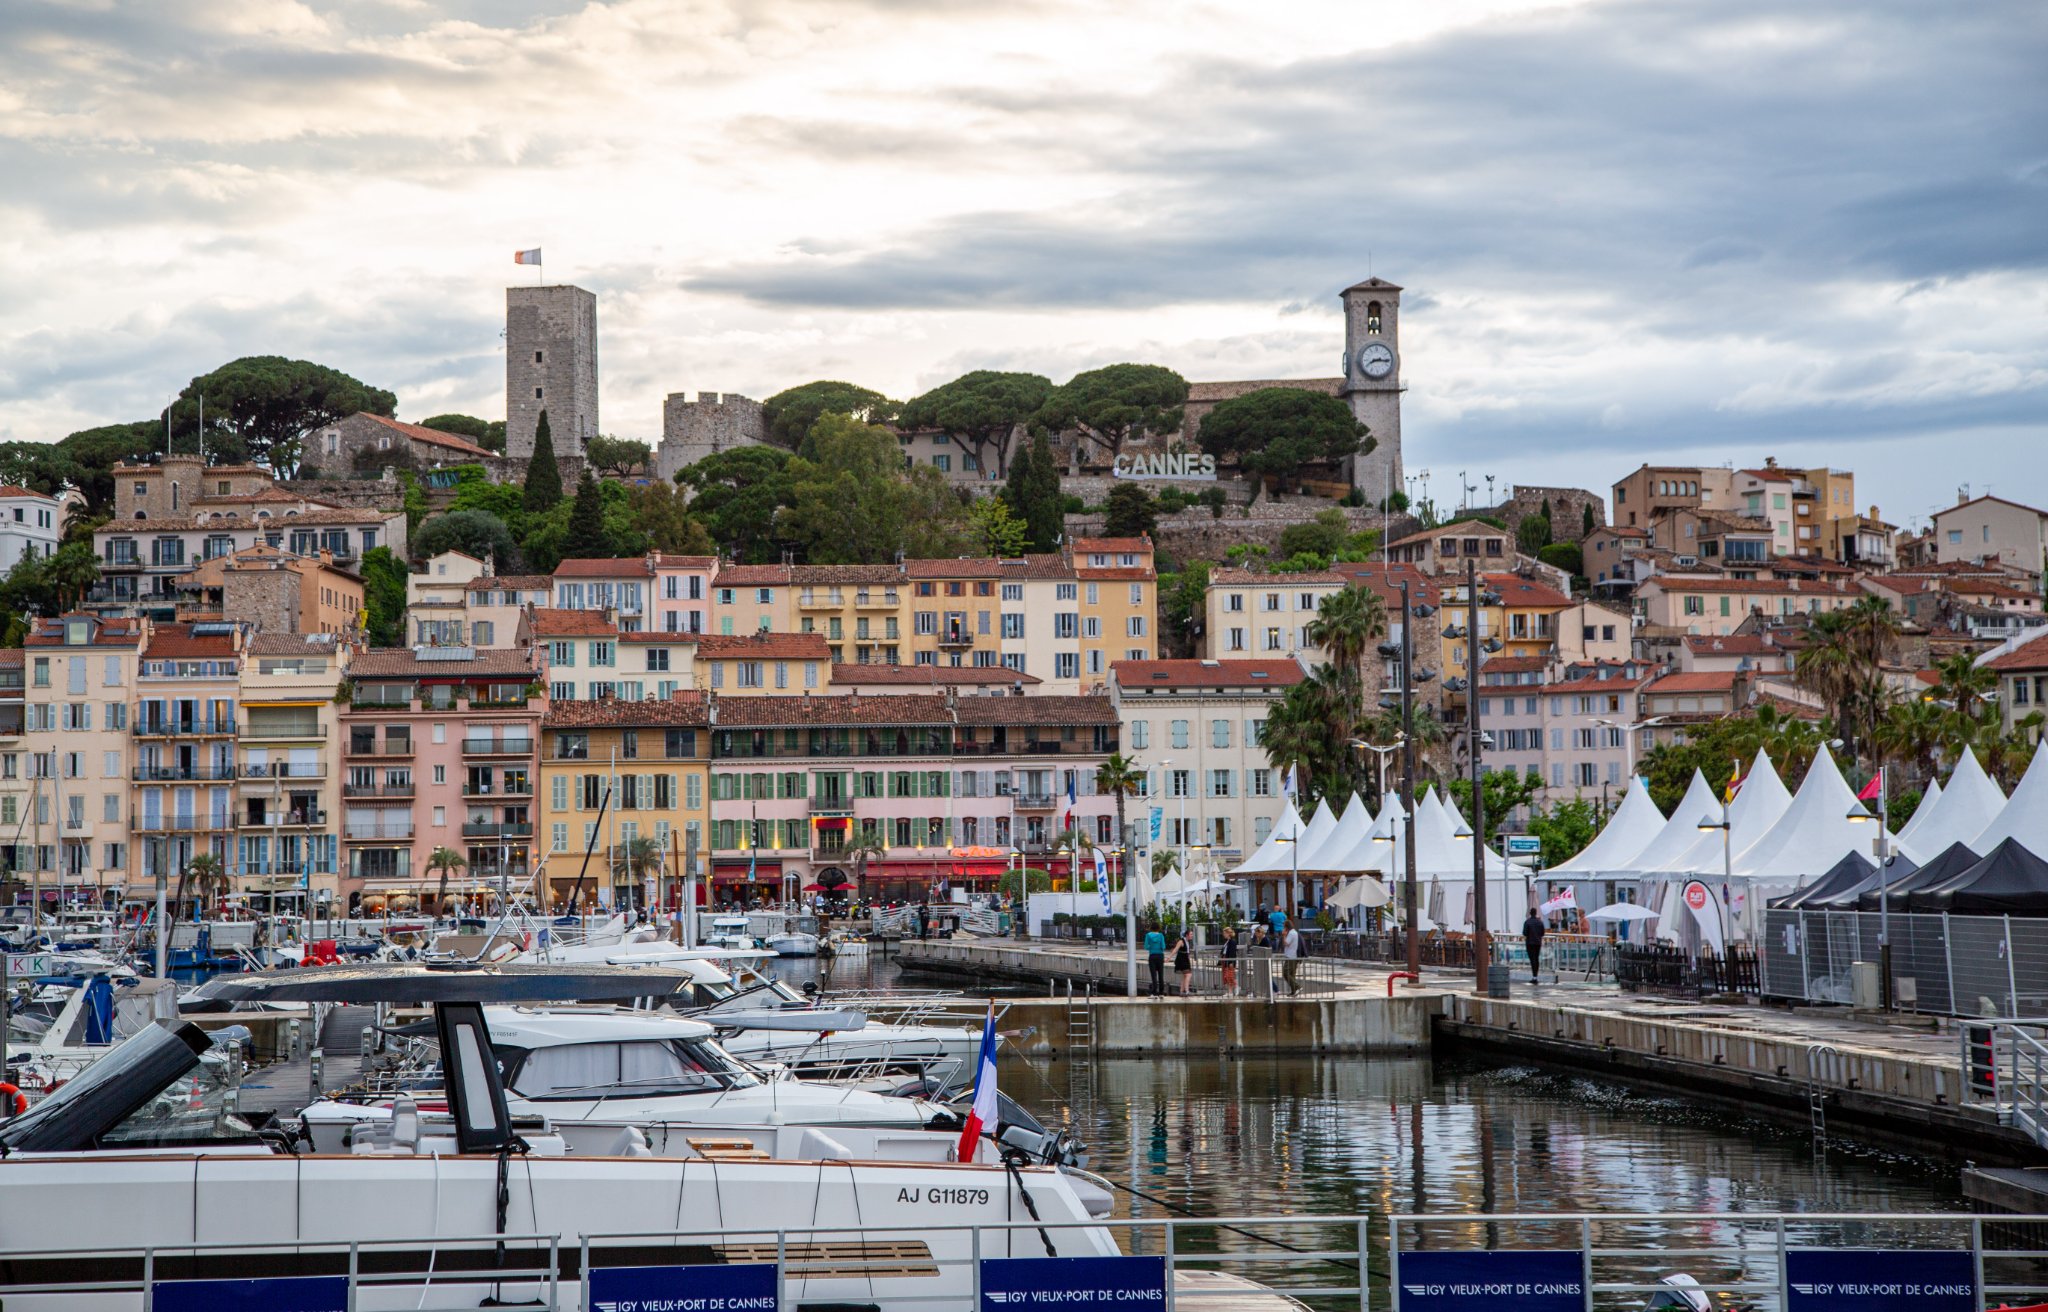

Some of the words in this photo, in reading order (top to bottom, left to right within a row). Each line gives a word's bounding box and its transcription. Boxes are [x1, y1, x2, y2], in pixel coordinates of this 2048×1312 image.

[1114, 453, 1216, 475] CANNES
[14, 958, 24, 971] K
[34, 958, 43, 971] K
[897, 1188, 920, 1203] AJ
[928, 1188, 989, 1205] G11879
[1008, 1292, 1028, 1302] IGY
[1031, 1291, 1095, 1302] VIEUX-PORT
[1098, 1290, 1113, 1301] DE
[1116, 1289, 1163, 1301] CANNES
[1426, 1285, 1446, 1295] IGY
[1449, 1284, 1513, 1295] VIEUX-PORT
[1517, 1284, 1531, 1295] DE
[1534, 1284, 1581, 1295] CANNES
[1814, 1284, 1834, 1294] IGY
[1837, 1284, 1902, 1295] VIEUX-PORT
[1906, 1285, 1920, 1295] DE
[1924, 1285, 1972, 1296] CANNES
[618, 1301, 637, 1312] IGY
[641, 1299, 706, 1311] VIEUX-PORT
[710, 1299, 725, 1309] DE
[728, 1297, 775, 1309] CANNES
